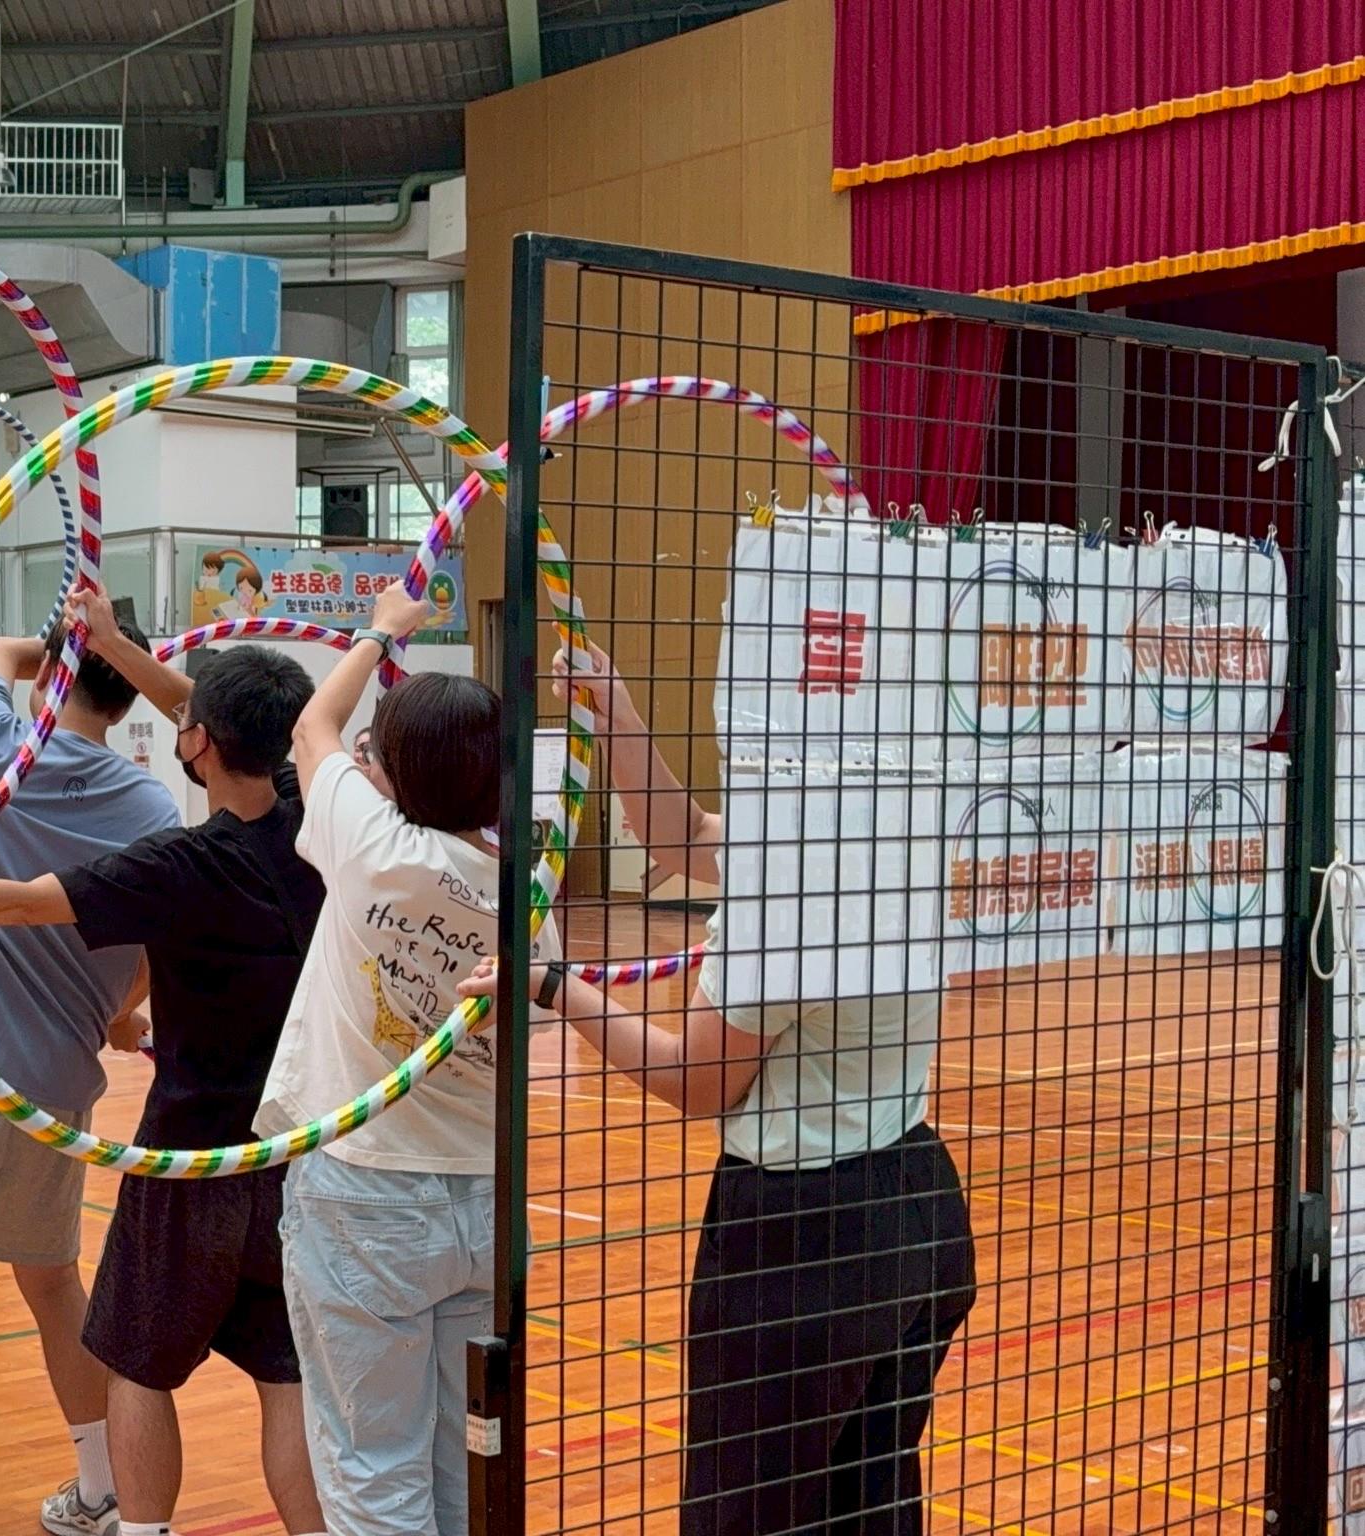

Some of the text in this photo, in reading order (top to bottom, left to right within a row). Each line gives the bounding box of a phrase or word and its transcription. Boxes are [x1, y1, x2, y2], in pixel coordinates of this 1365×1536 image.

[271, 572, 401, 596] 生活品德 品德
[949, 847, 1097, 921] 動態展演
[366, 902, 488, 956] the Rose
